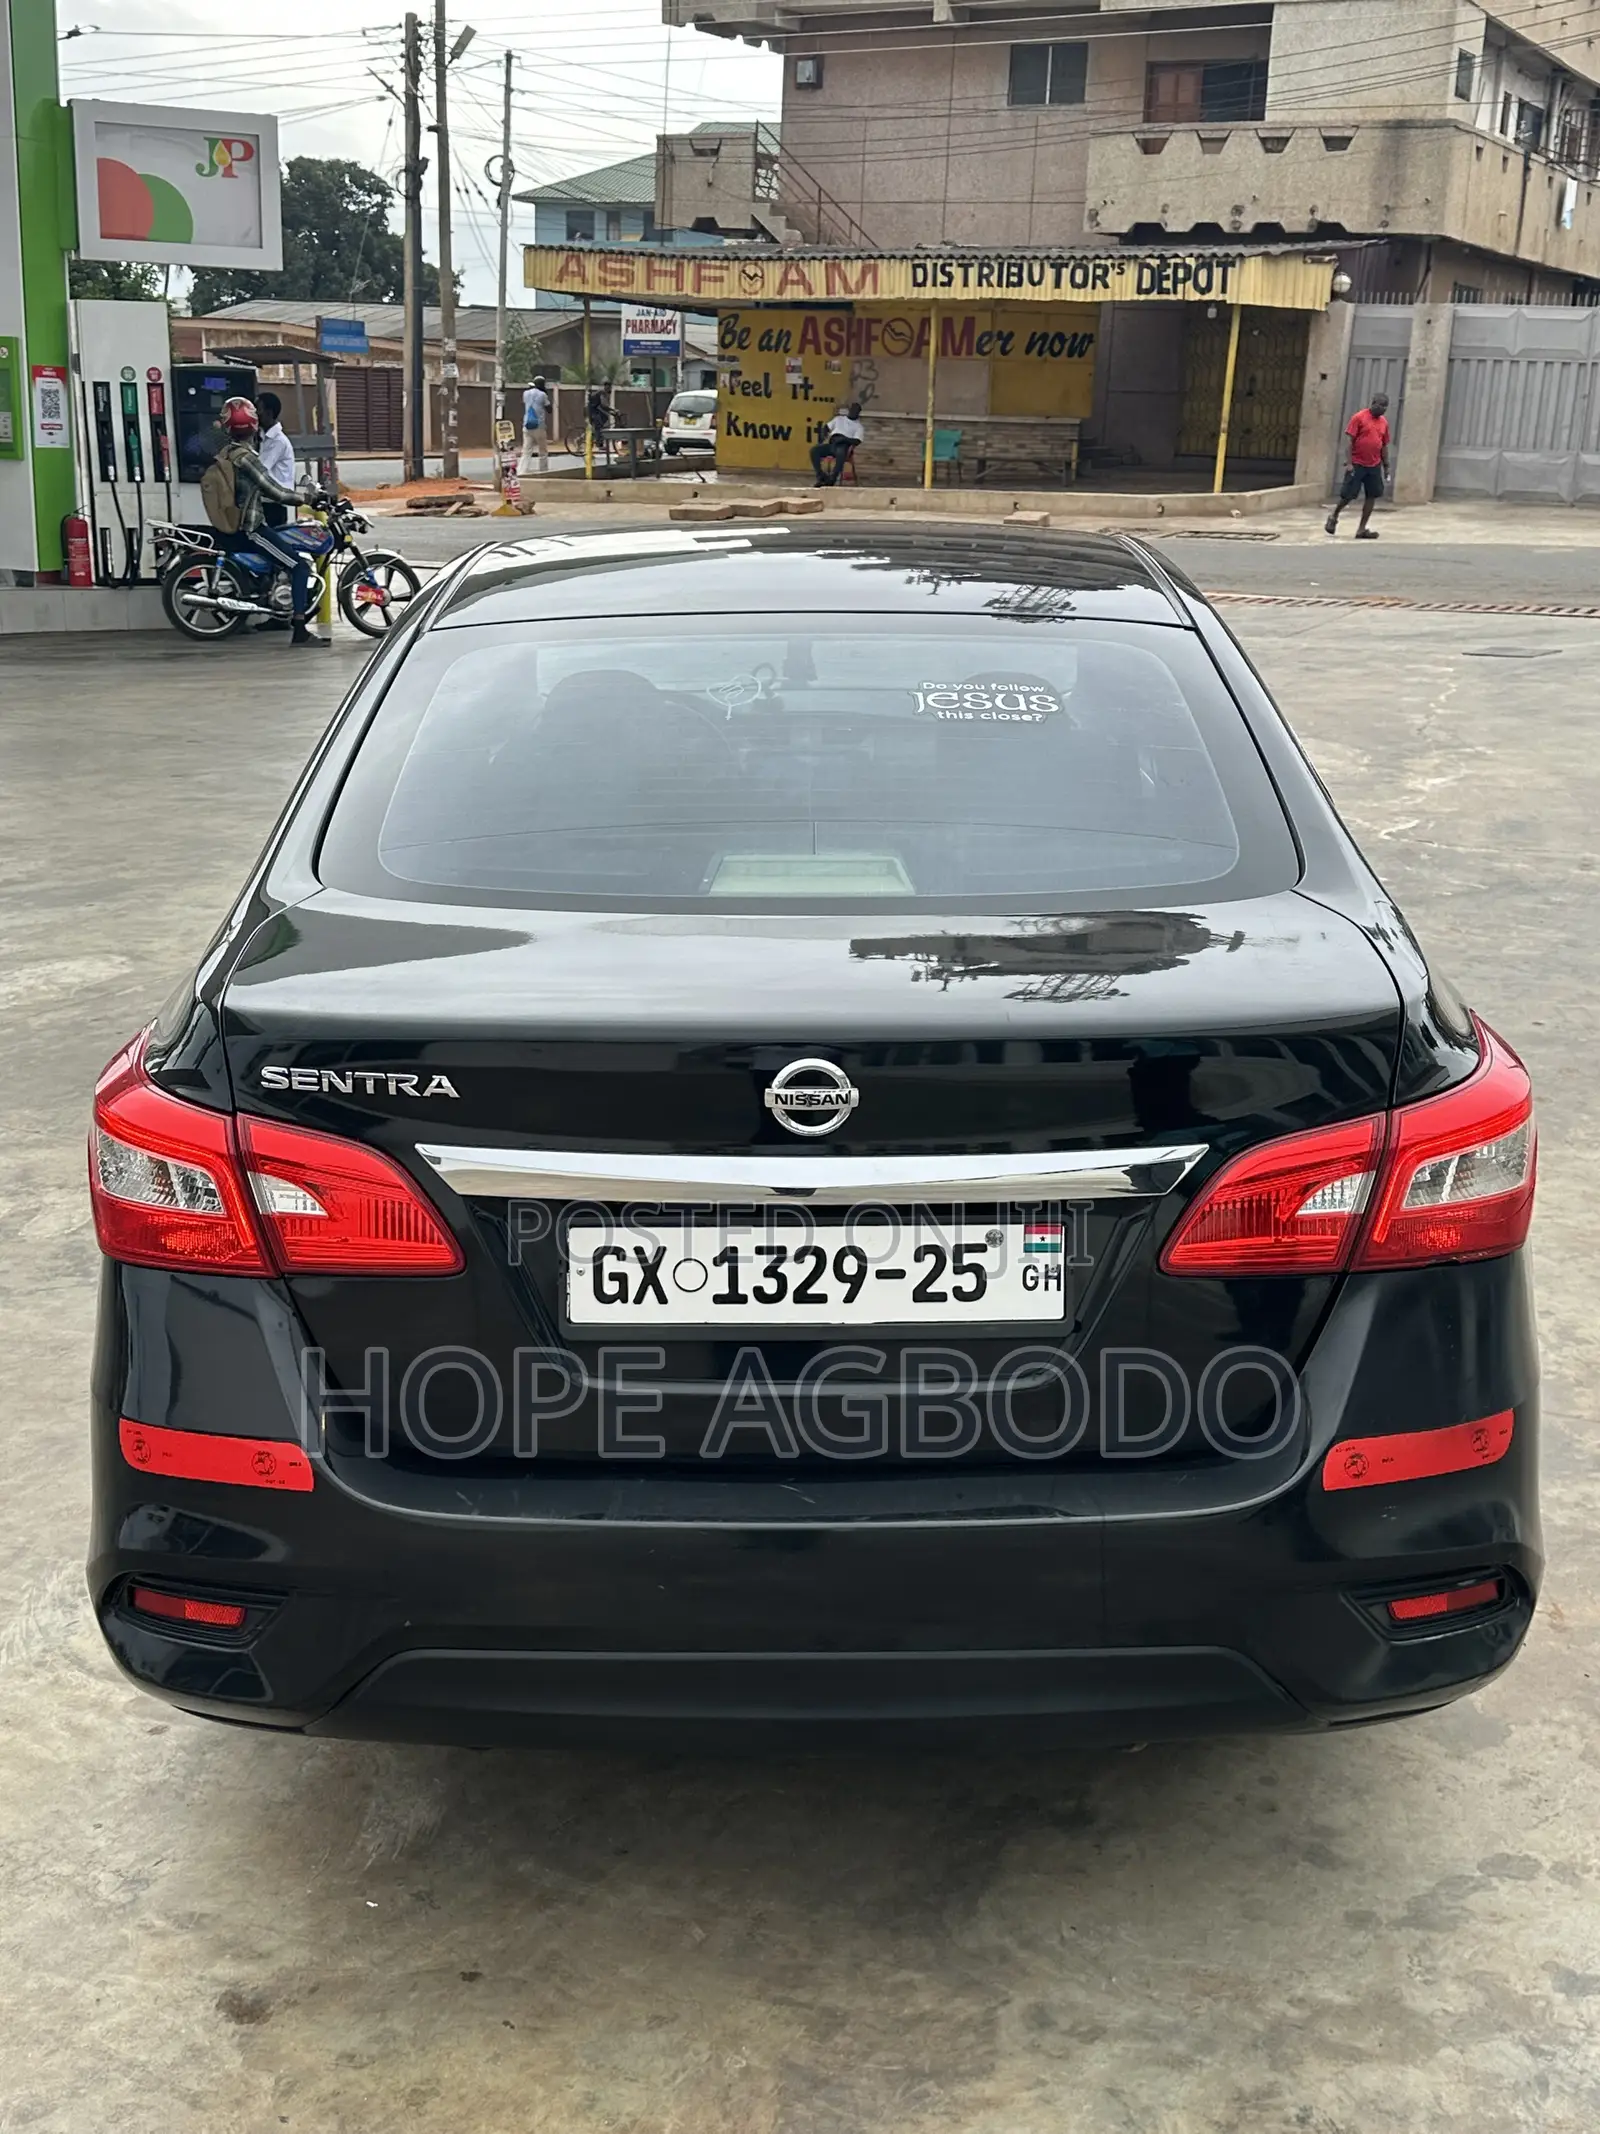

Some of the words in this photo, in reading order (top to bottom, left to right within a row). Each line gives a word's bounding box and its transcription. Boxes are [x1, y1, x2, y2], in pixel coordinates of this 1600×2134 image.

[1136, 257, 1236, 295] DEPOT
[626, 319, 677, 335] PHARMACY
[719, 313, 752, 350] Be
[758, 328, 792, 353] an
[1024, 331, 1095, 358] now
[728, 370, 772, 399] Feel
[726, 411, 792, 441] Know
[923, 682, 947, 690] Do
[953, 683, 985, 691] you
[990, 683, 1045, 692] follow
[938, 711, 974, 720] this
[980, 711, 1043, 722] close?
[260, 1066, 461, 1098] SENTRA
[774, 1093, 849, 1106] NISSAN
[592, 1245, 669, 1305] GX
[712, 1243, 988, 1304] 1329-25
[1022, 1264, 1062, 1292] GH
